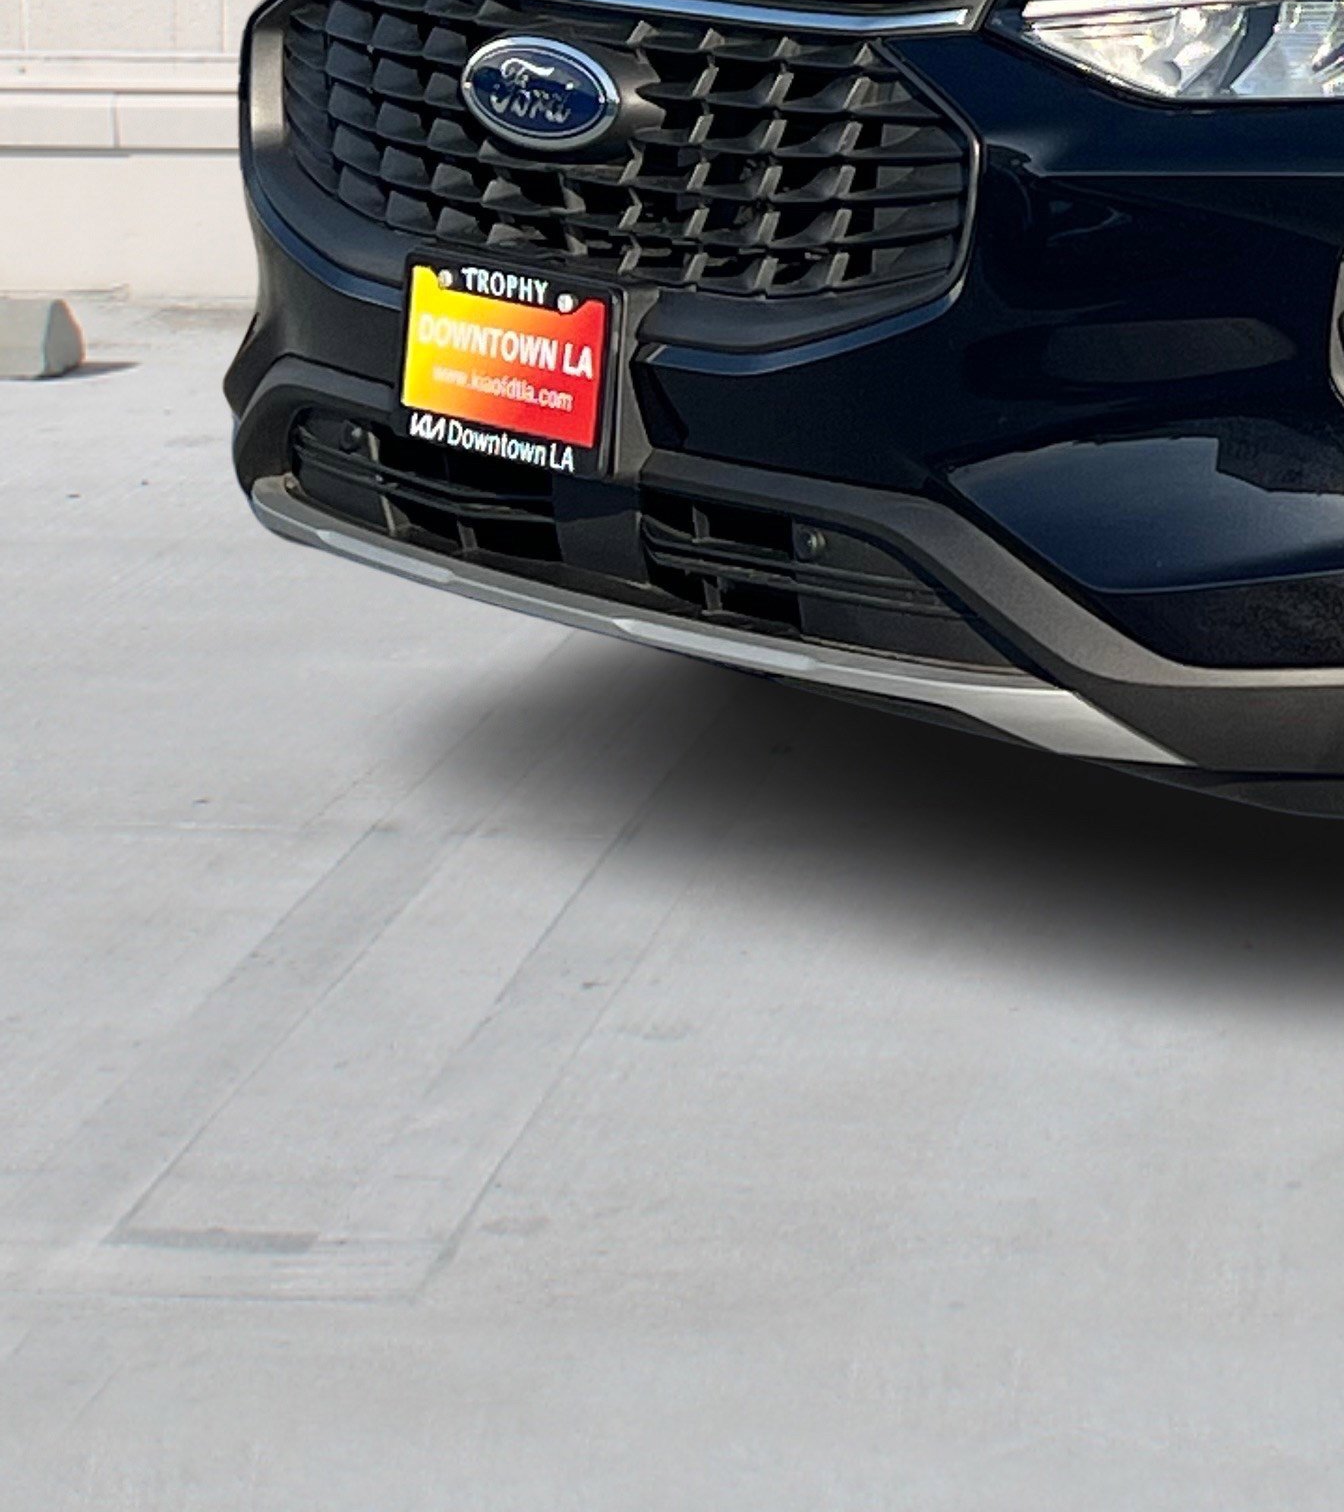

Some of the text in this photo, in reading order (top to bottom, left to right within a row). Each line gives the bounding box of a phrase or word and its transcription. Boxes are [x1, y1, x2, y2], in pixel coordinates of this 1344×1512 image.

[461, 267, 549, 305] TROPHY
[417, 313, 593, 381] DOWNTOWN LA
[448, 419, 548, 467] Downtown
[550, 443, 576, 473] LA
